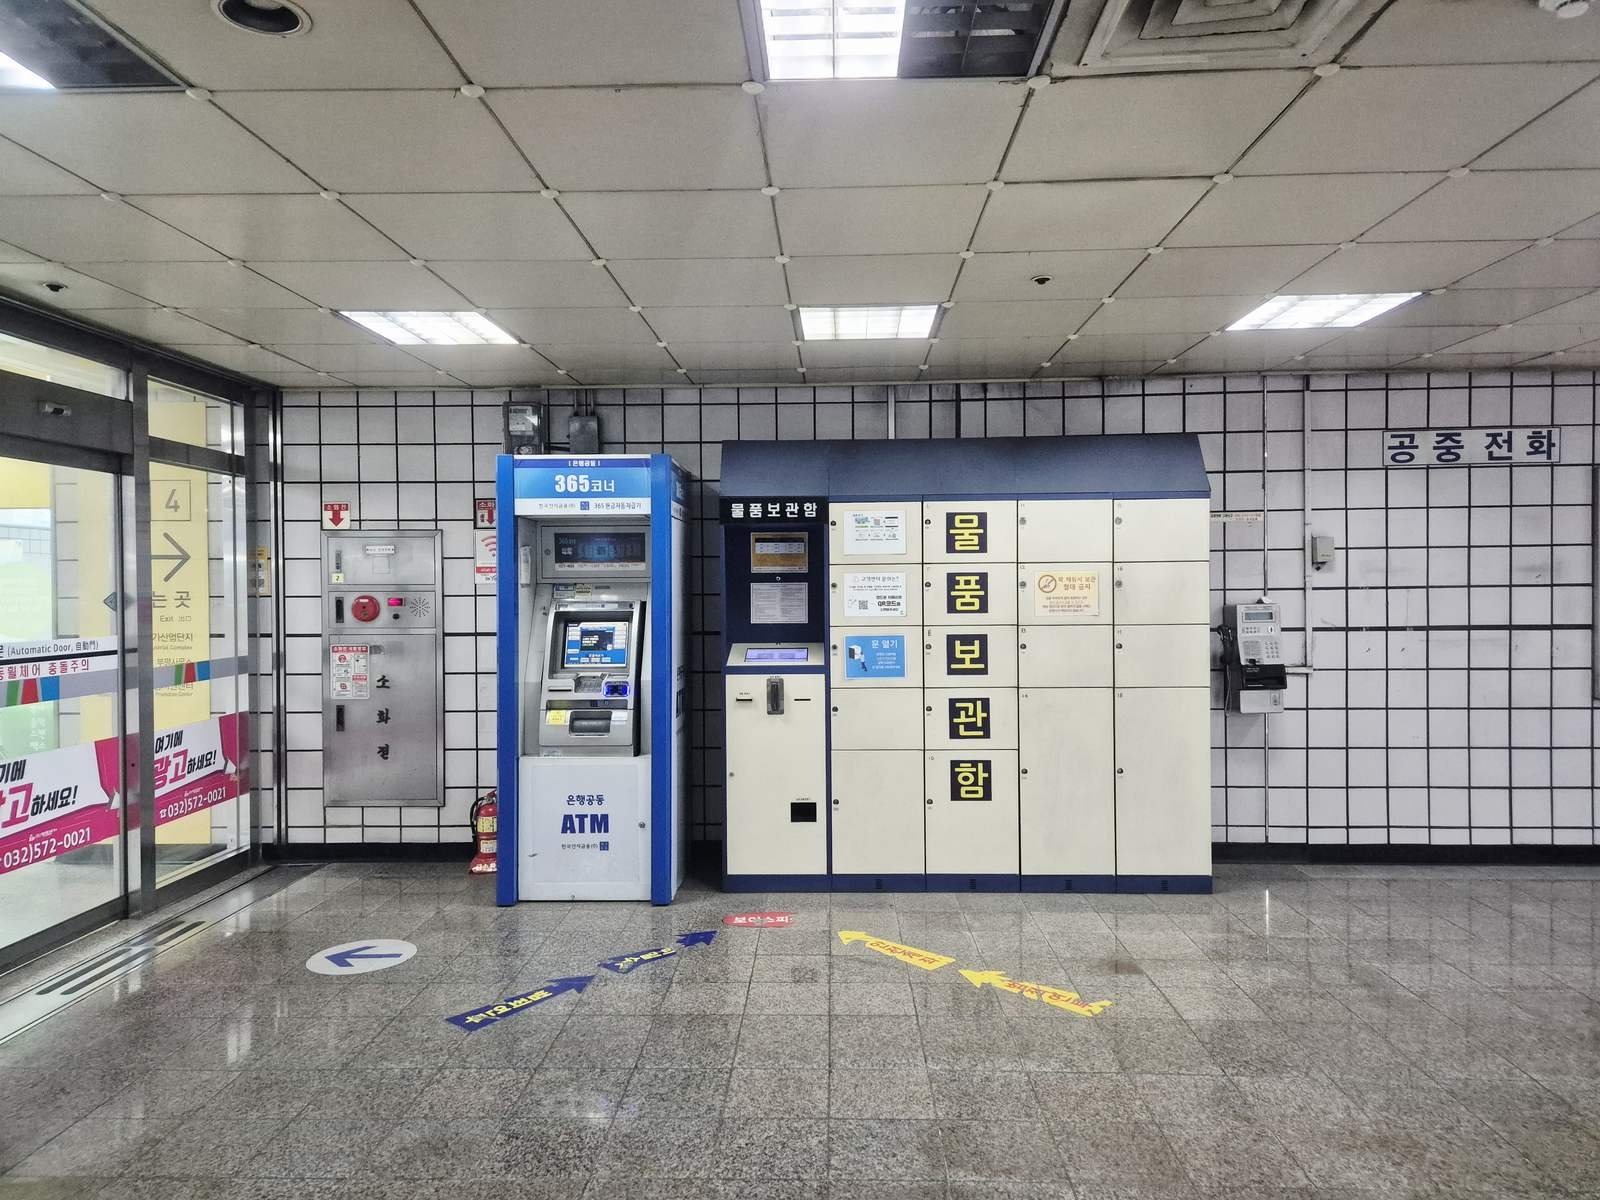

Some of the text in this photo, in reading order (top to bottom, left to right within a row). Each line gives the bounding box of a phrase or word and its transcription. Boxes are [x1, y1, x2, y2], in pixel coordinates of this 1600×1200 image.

[554, 474, 616, 493] 365코너
[164, 488, 181, 513] 4
[730, 502, 818, 519] 물품보관함
[174, 591, 191, 608] 곳
[7, 645, 51, 657] (Automatic
[53, 643, 74, 654] Door,
[155, 730, 184, 754] 여기에
[566, 794, 605, 806] 은행공동
[560, 813, 610, 834] ATM
[3, 826, 91, 868] 032)572-0021
